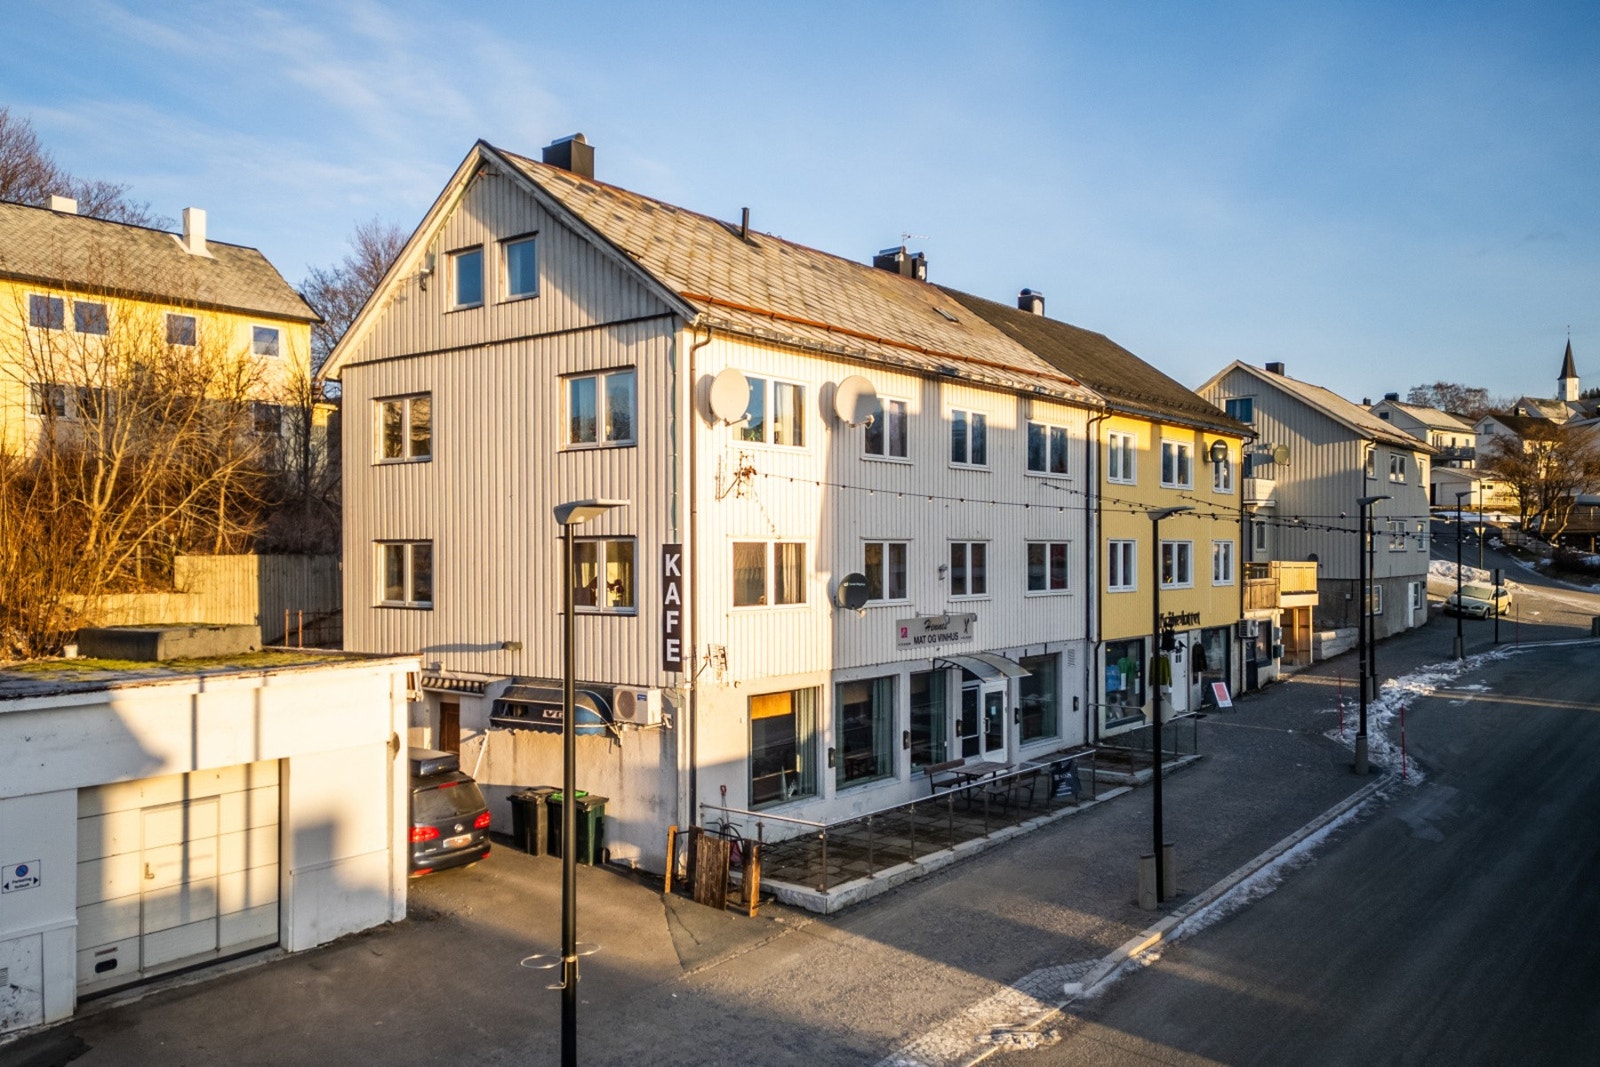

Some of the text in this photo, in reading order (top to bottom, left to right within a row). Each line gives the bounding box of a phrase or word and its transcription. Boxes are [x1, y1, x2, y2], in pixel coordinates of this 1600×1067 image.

[664, 553, 682, 662] KAFE
[913, 635, 926, 645] MAT
[927, 634, 937, 643] OG
[937, 632, 959, 642] VINHUS
